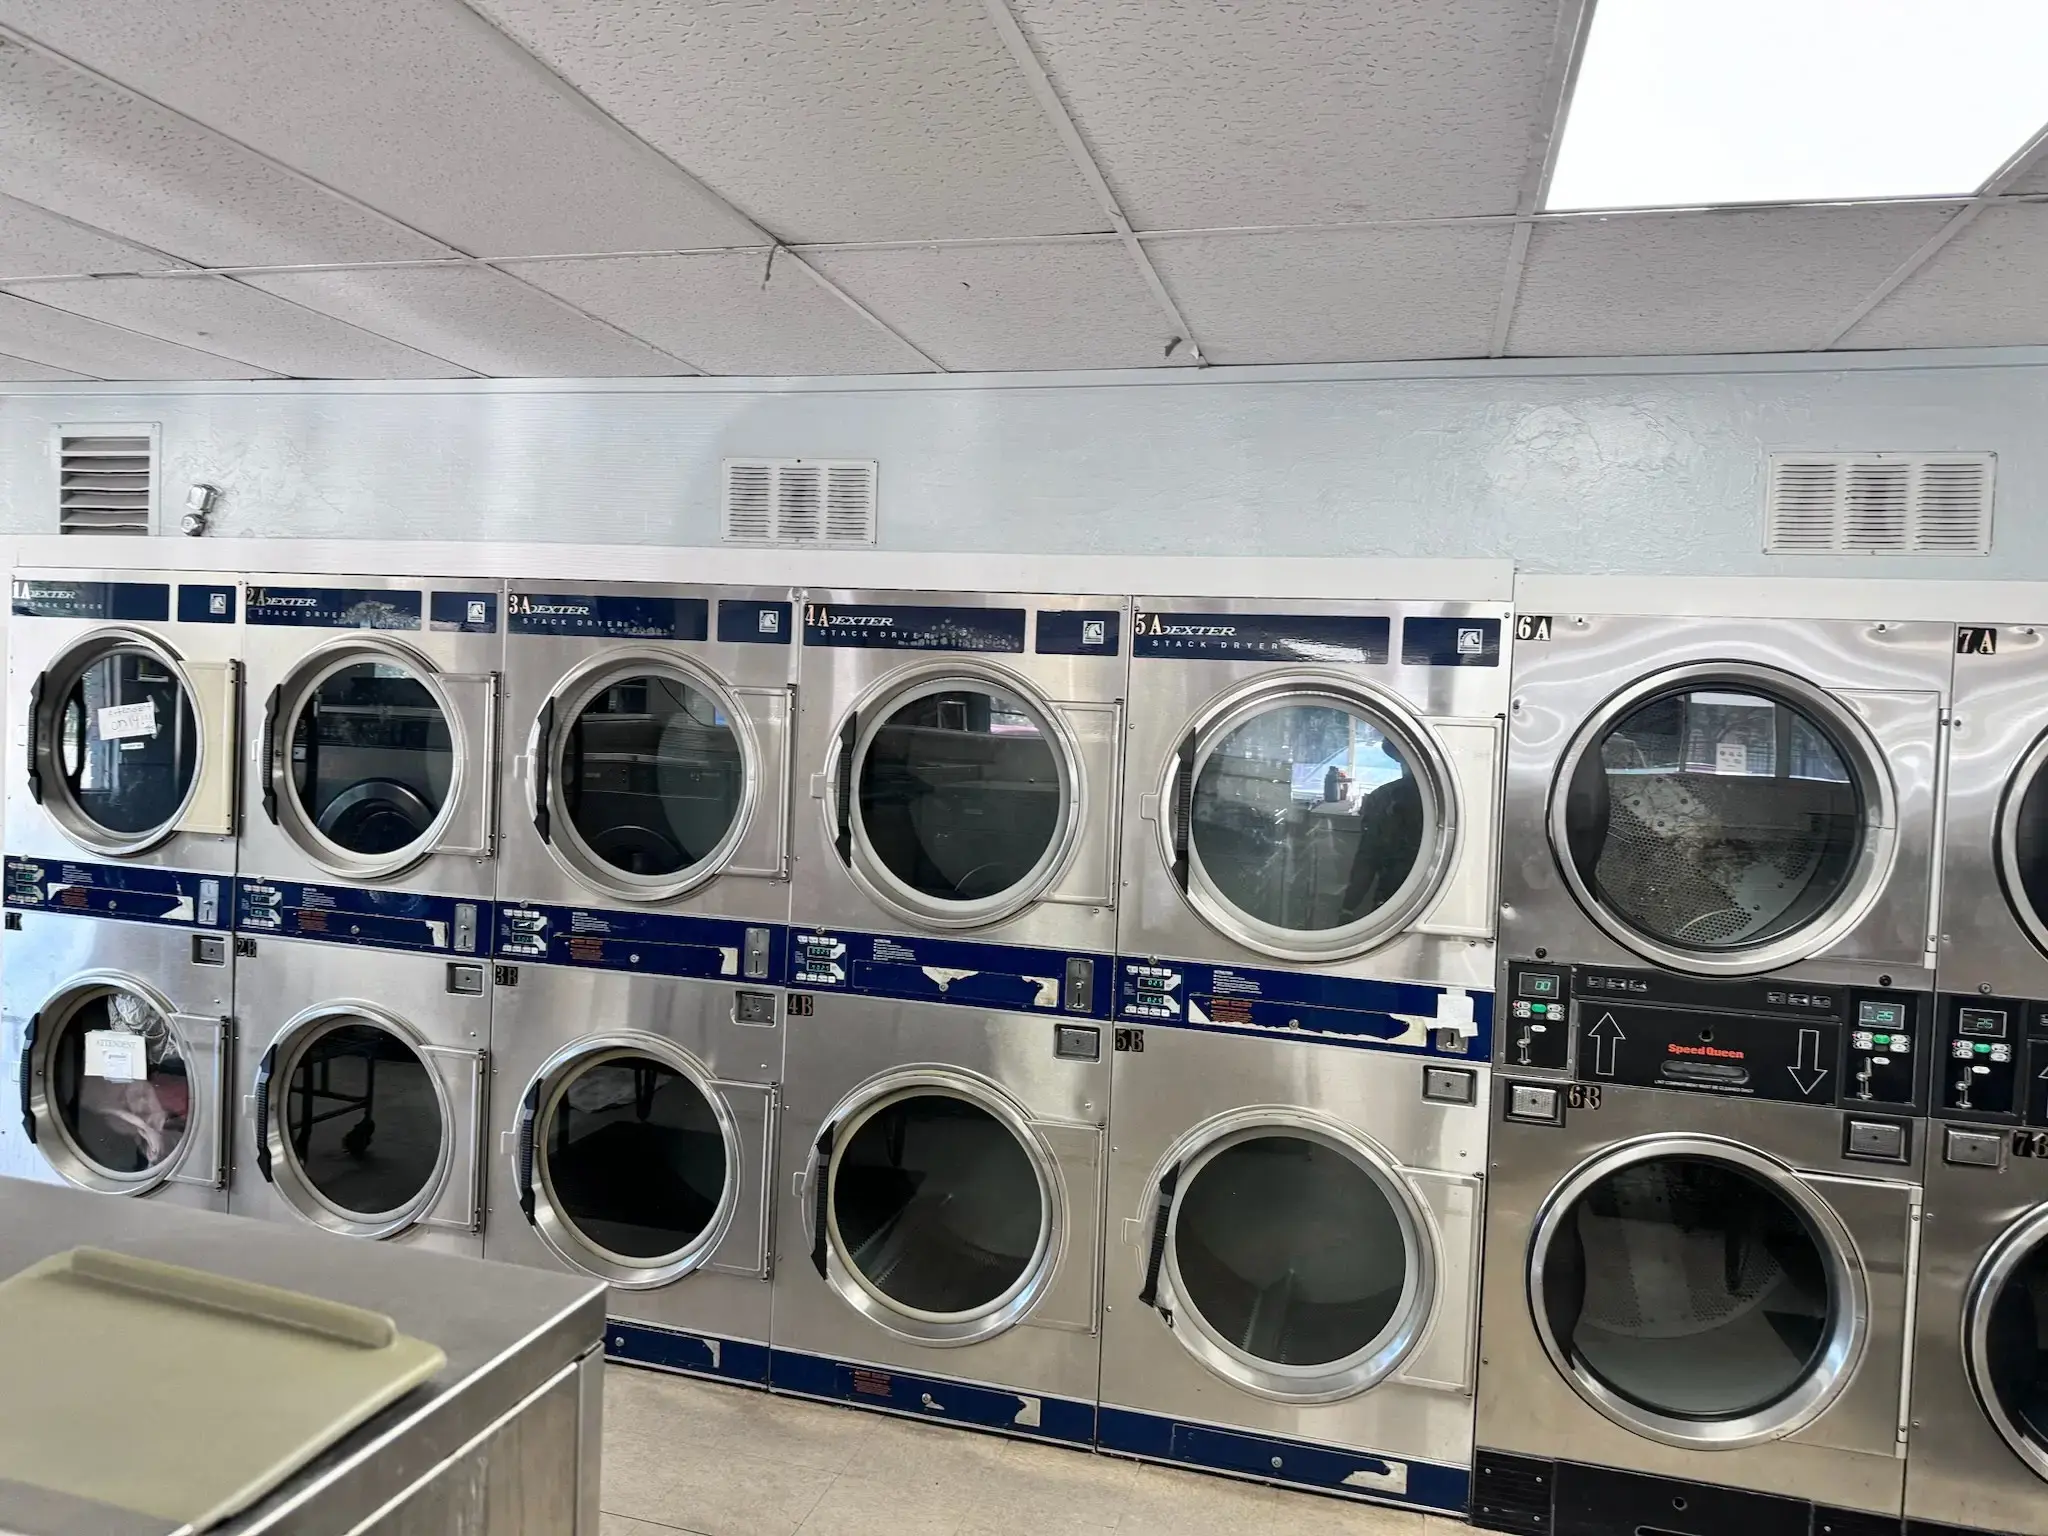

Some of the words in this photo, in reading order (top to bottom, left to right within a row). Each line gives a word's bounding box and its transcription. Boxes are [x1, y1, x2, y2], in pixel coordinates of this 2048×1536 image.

[12, 581, 31, 600] 1A
[247, 587, 267, 607] 2A
[258, 608, 297, 617] STACK
[305, 610, 346, 619] DRYER
[509, 594, 531, 615] 3A
[522, 618, 567, 626] STACK
[577, 620, 623, 628] DRYER
[805, 604, 830, 628] 4A
[1134, 614, 1164, 636] 5A
[820, 629, 869, 638] STACK
[880, 631, 930, 640] DRYER
[1518, 616, 1551, 641] 6A
[1152, 639, 1207, 648] STACK
[1220, 641, 1279, 650] DRYER
[1958, 628, 1996, 654] 7A
[788, 995, 813, 1016] 4B
[1116, 1030, 1144, 1051] 5B
[1668, 1043, 1705, 1055] Speed
[1706, 1046, 1745, 1059] Queen
